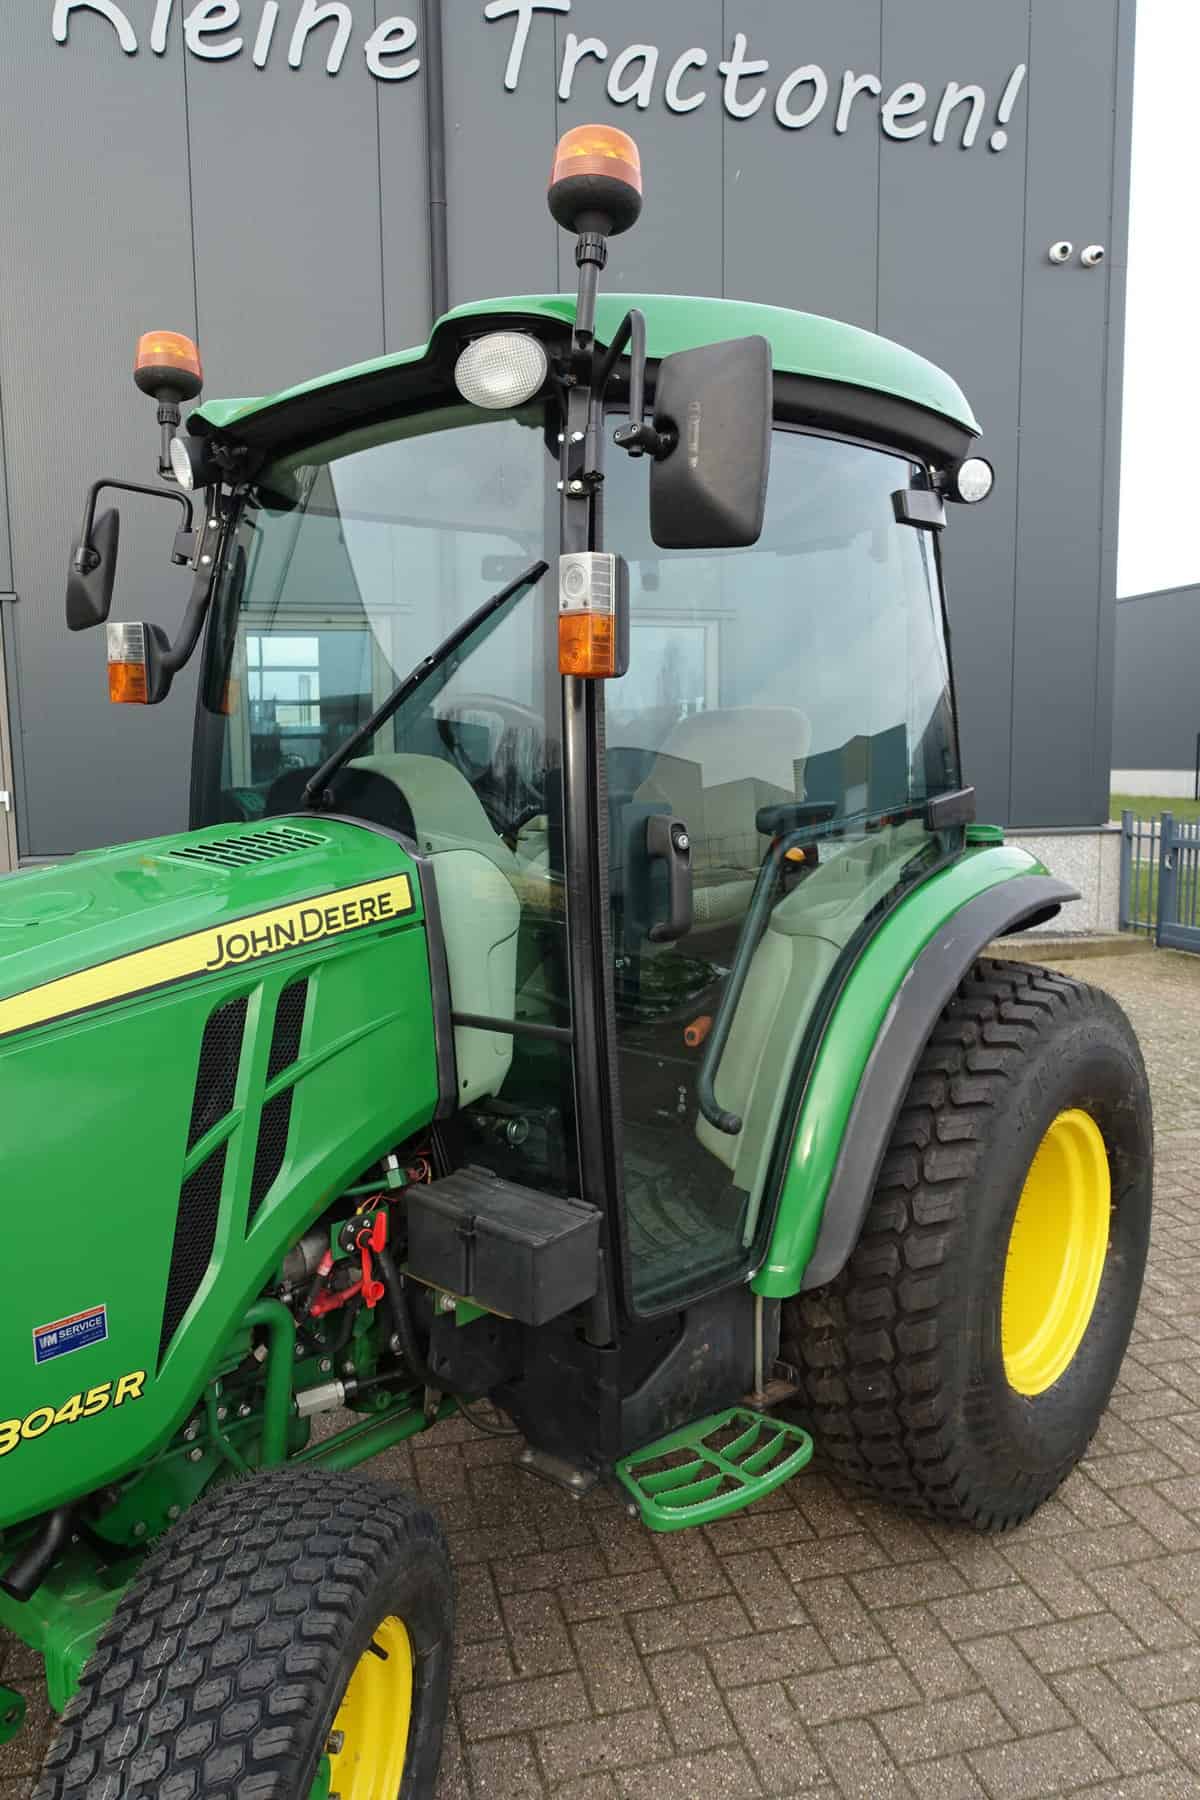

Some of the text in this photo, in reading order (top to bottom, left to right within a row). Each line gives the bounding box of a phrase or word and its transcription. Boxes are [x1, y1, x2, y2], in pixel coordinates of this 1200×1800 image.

[484, 0, 1027, 152] Tractoren!
[206, 892, 394, 966] JOHN DEERE
[58, 1316, 103, 1338] SERVICE
